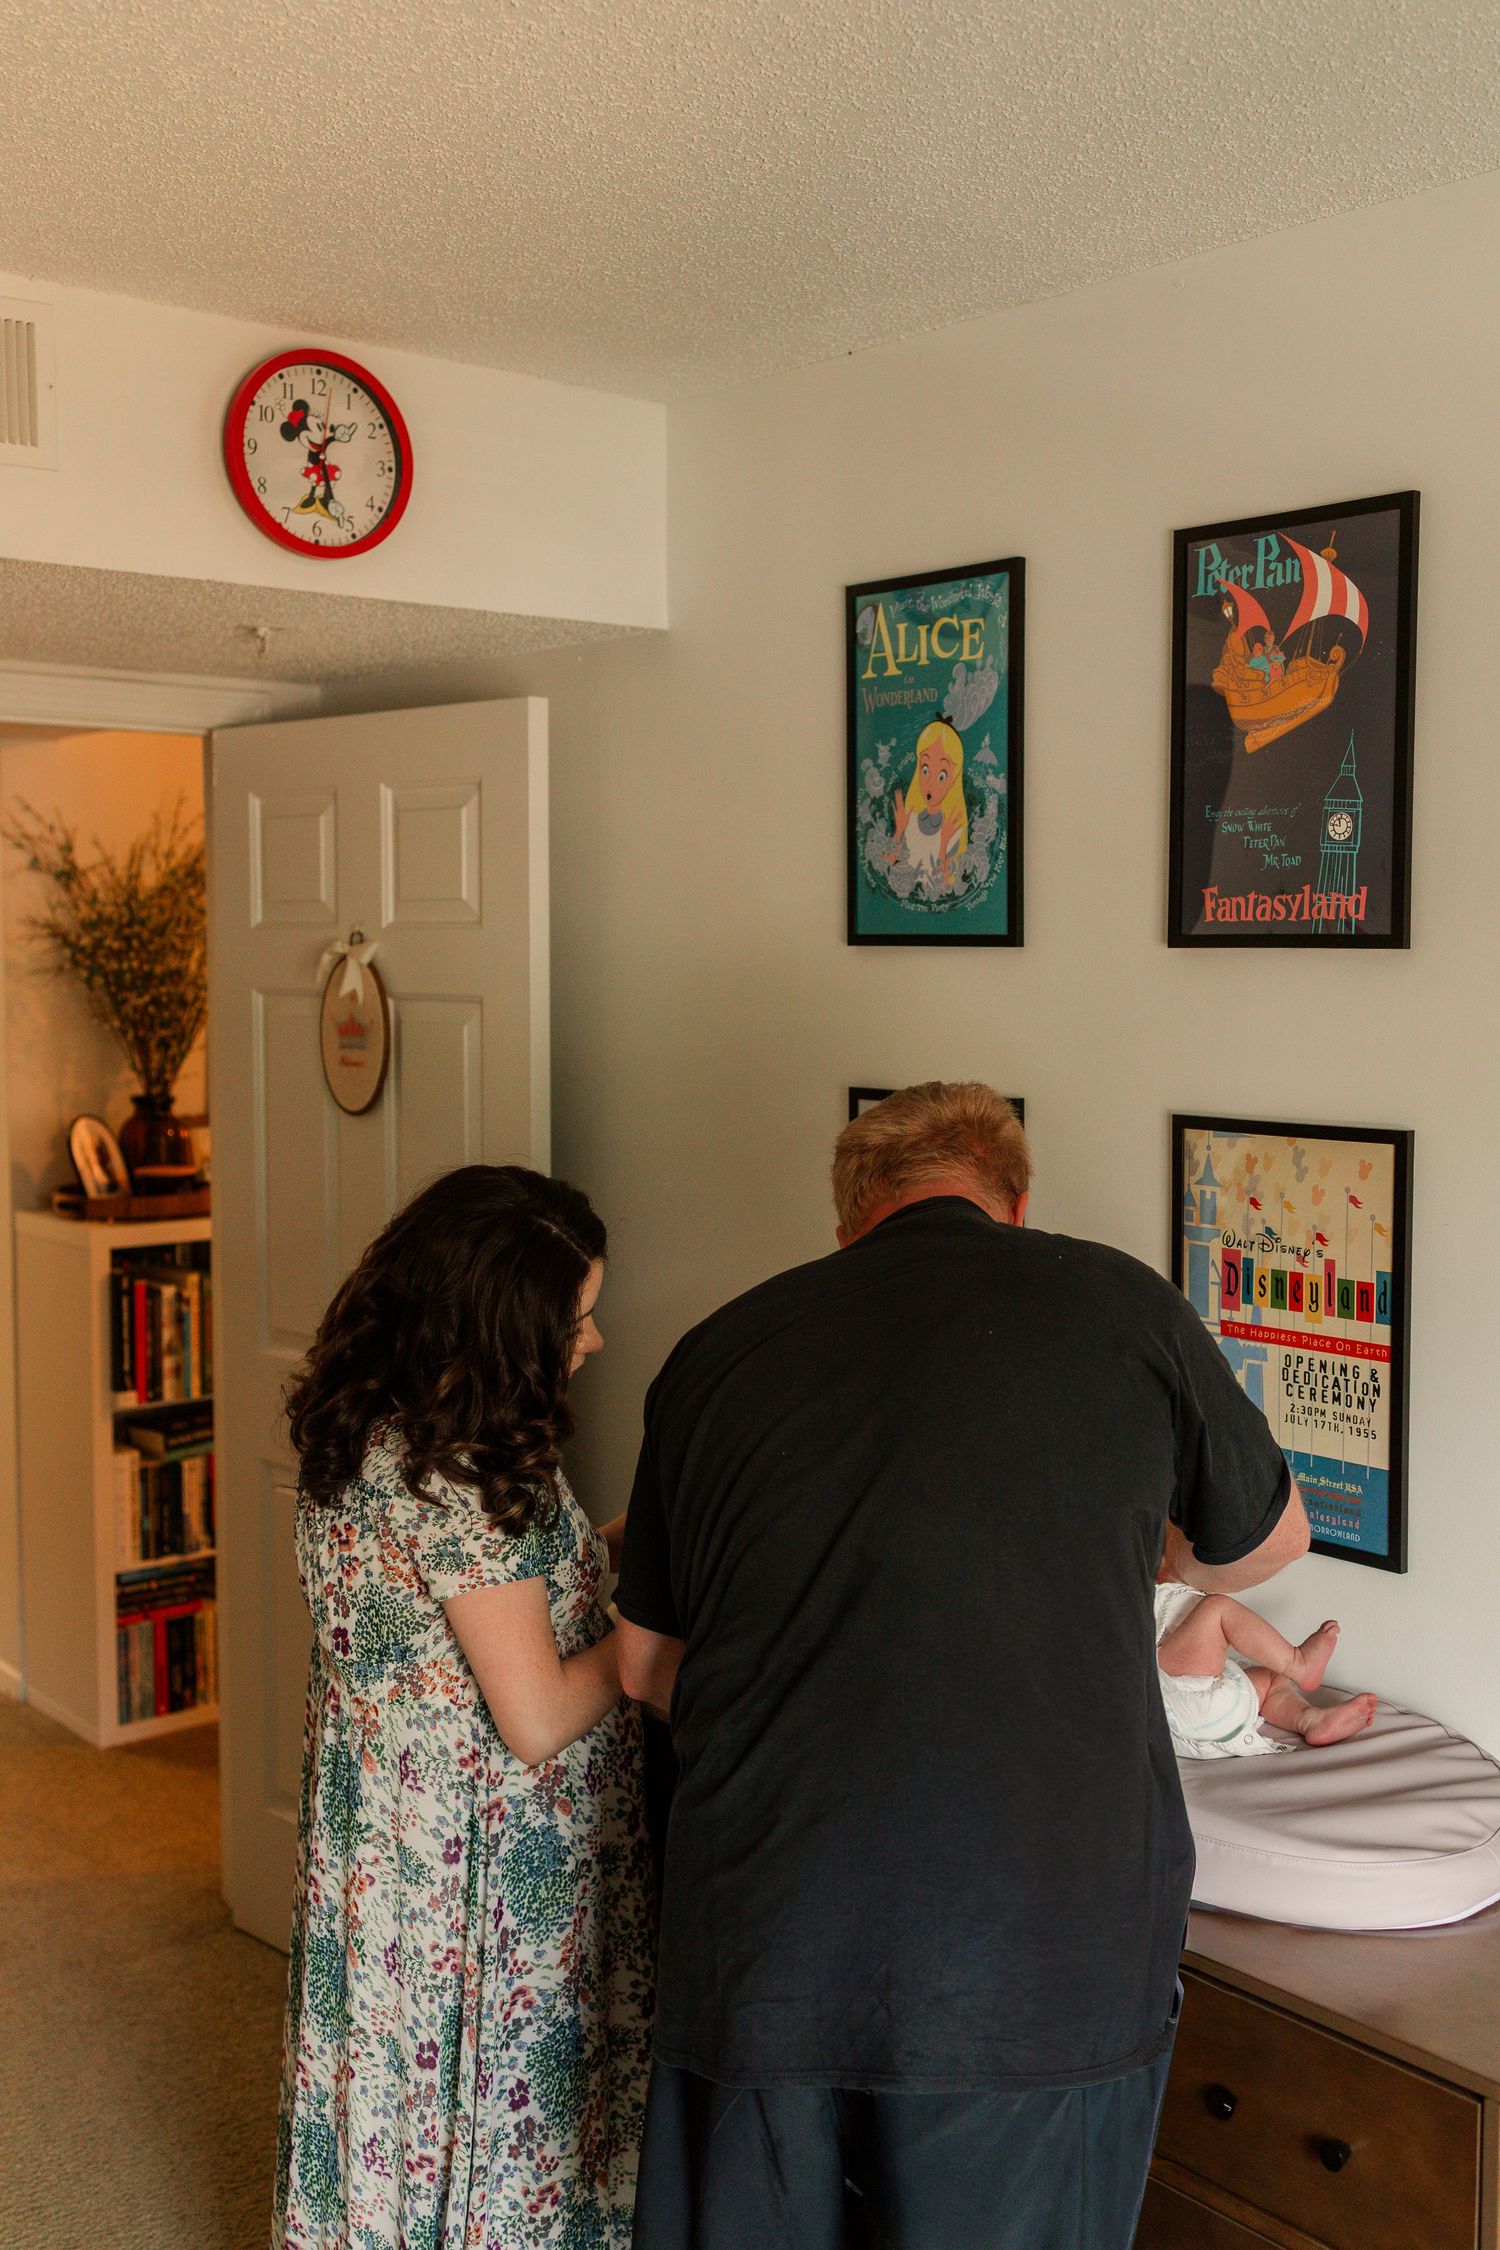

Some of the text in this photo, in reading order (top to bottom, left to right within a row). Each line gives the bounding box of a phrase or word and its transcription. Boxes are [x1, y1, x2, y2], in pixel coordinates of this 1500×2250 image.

[282, 382, 295, 400] 11
[310, 378, 328, 397] 12
[346, 393, 352, 410] 1
[258, 404, 275, 423] 10
[367, 422, 377, 440] 2
[247, 438, 258, 455] 9
[376, 460, 386, 477] 3
[257, 476, 267, 494] 8
[365, 495, 375, 511] 4
[281, 506, 291, 523] 7
[345, 515, 355, 533] 5
[312, 520, 322, 537] 6
[1191, 533, 1301, 598] Peter Pan
[861, 602, 985, 679] ALICE
[861, 686, 938, 716] WONDERLAND
[1243, 834, 1287, 850] PETER PAN
[1280, 853, 1302, 870] TOAD
[1201, 884, 1368, 922] Fantasyland
[1223, 1260, 1388, 1316] Disneyland
[1226, 1324, 1388, 1358] The Happiest Place On Earth
[1284, 1354, 1380, 1383] OPENING &
[1282, 1367, 1381, 1398] DEDICATION
[1285, 1383, 1377, 1413] CEREMONY
[1290, 1403, 1371, 1427] 2:30PM SUNDAY
[1284, 1413, 1309, 1426] JULY
[1348, 1426, 1377, 1440] 1955
[1310, 1523, 1361, 1542] ORROWLAND
